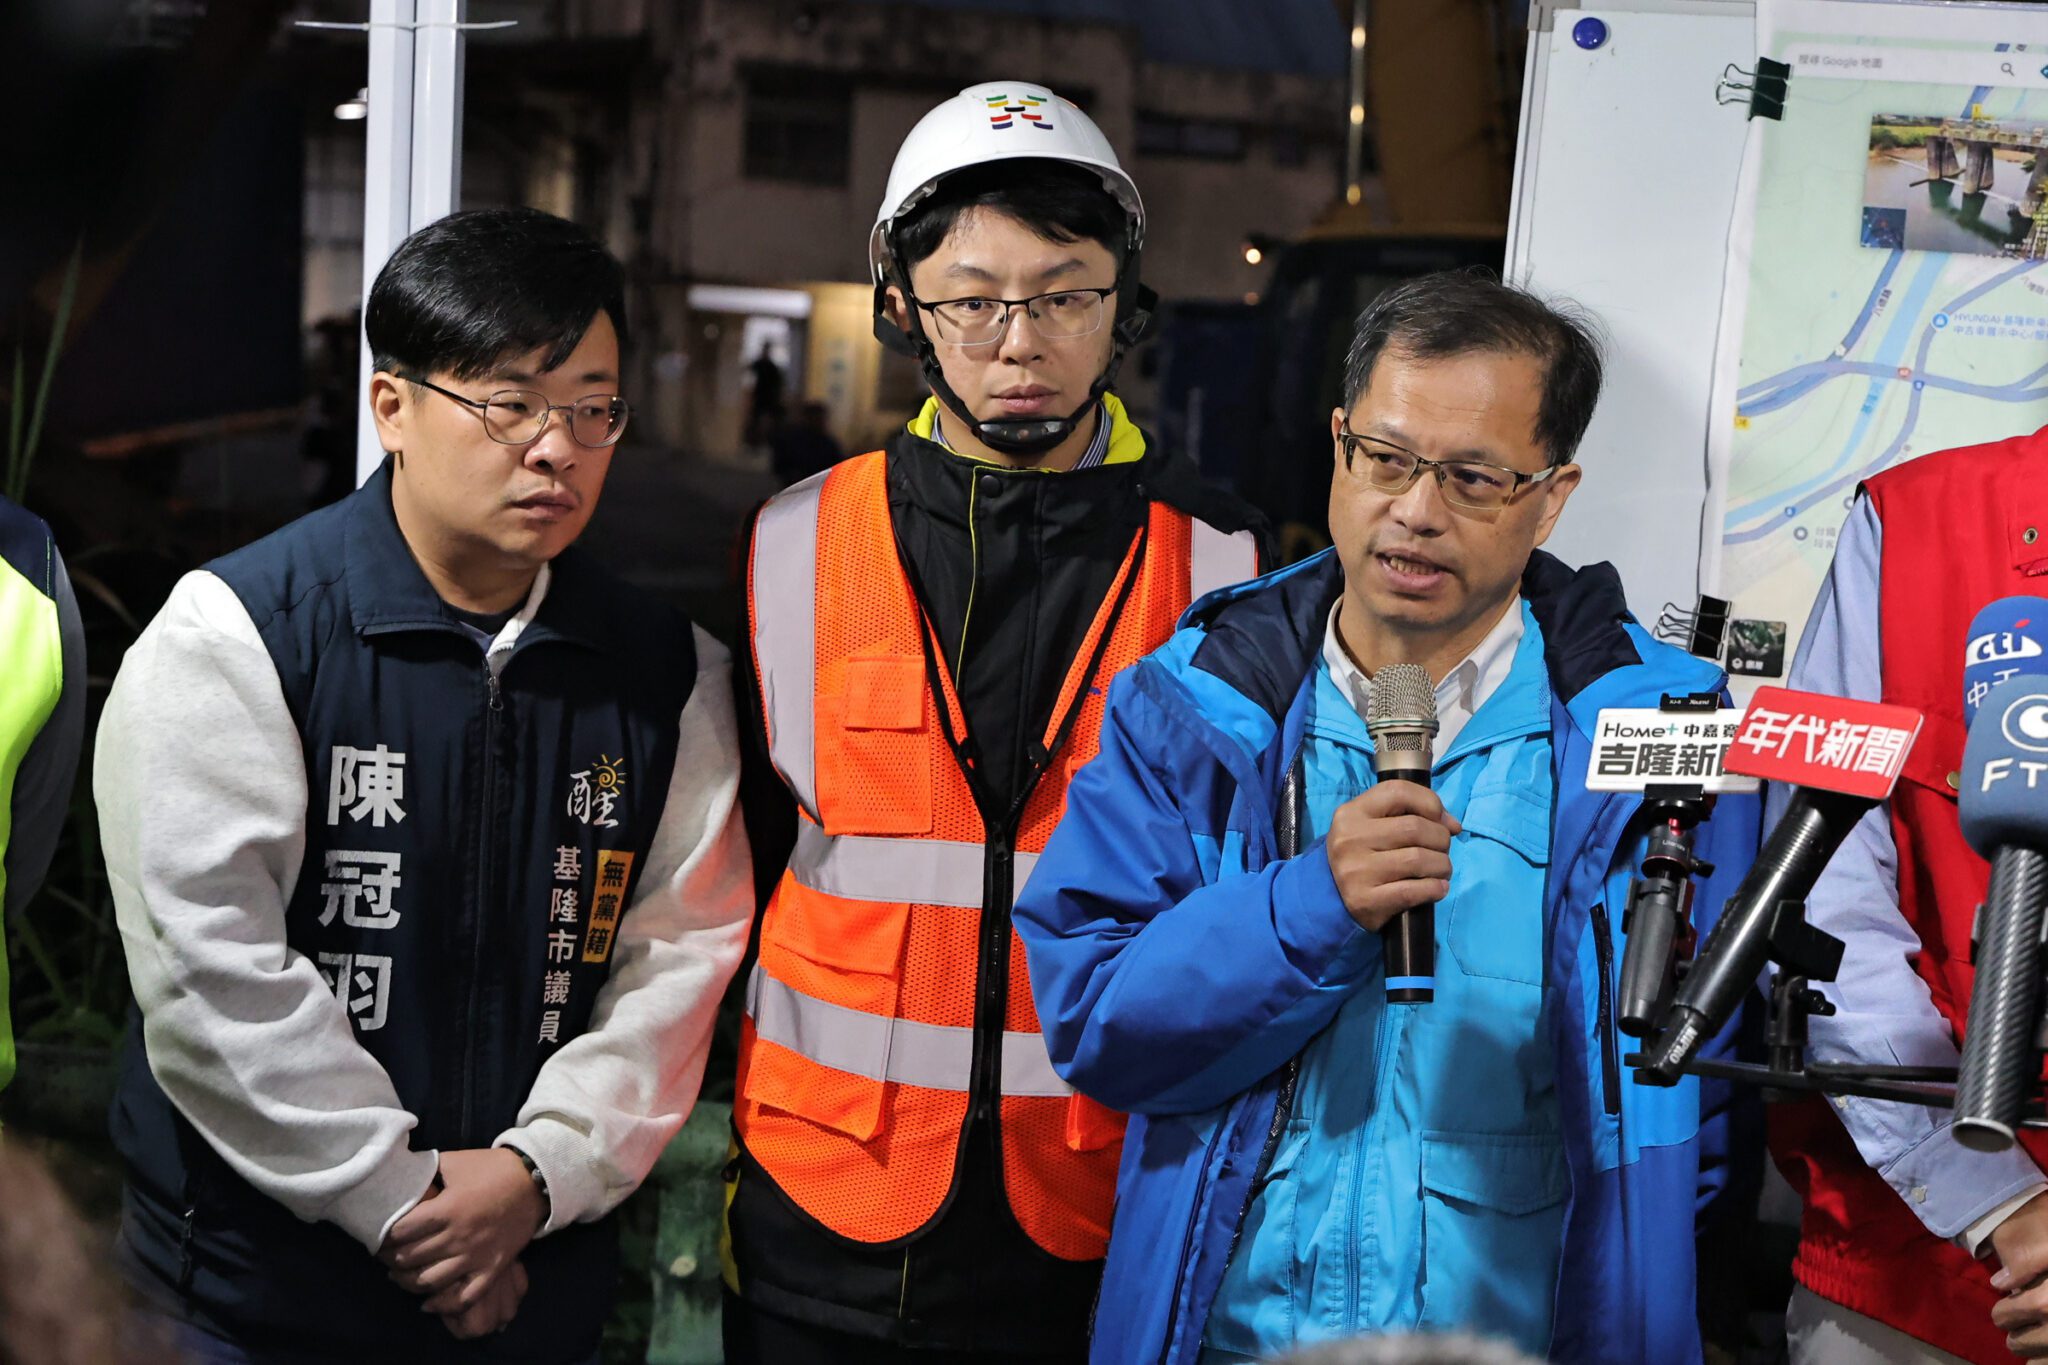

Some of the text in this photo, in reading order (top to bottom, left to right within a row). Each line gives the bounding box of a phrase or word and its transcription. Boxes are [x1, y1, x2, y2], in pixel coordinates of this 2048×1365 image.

[1597, 743, 1737, 777] 吉隆新
[1738, 707, 1911, 778] 年代新聞
[317, 743, 407, 1031] 陳冠羽
[585, 858, 626, 956] 無黨籍
[537, 845, 582, 1045] 基隆市議員
